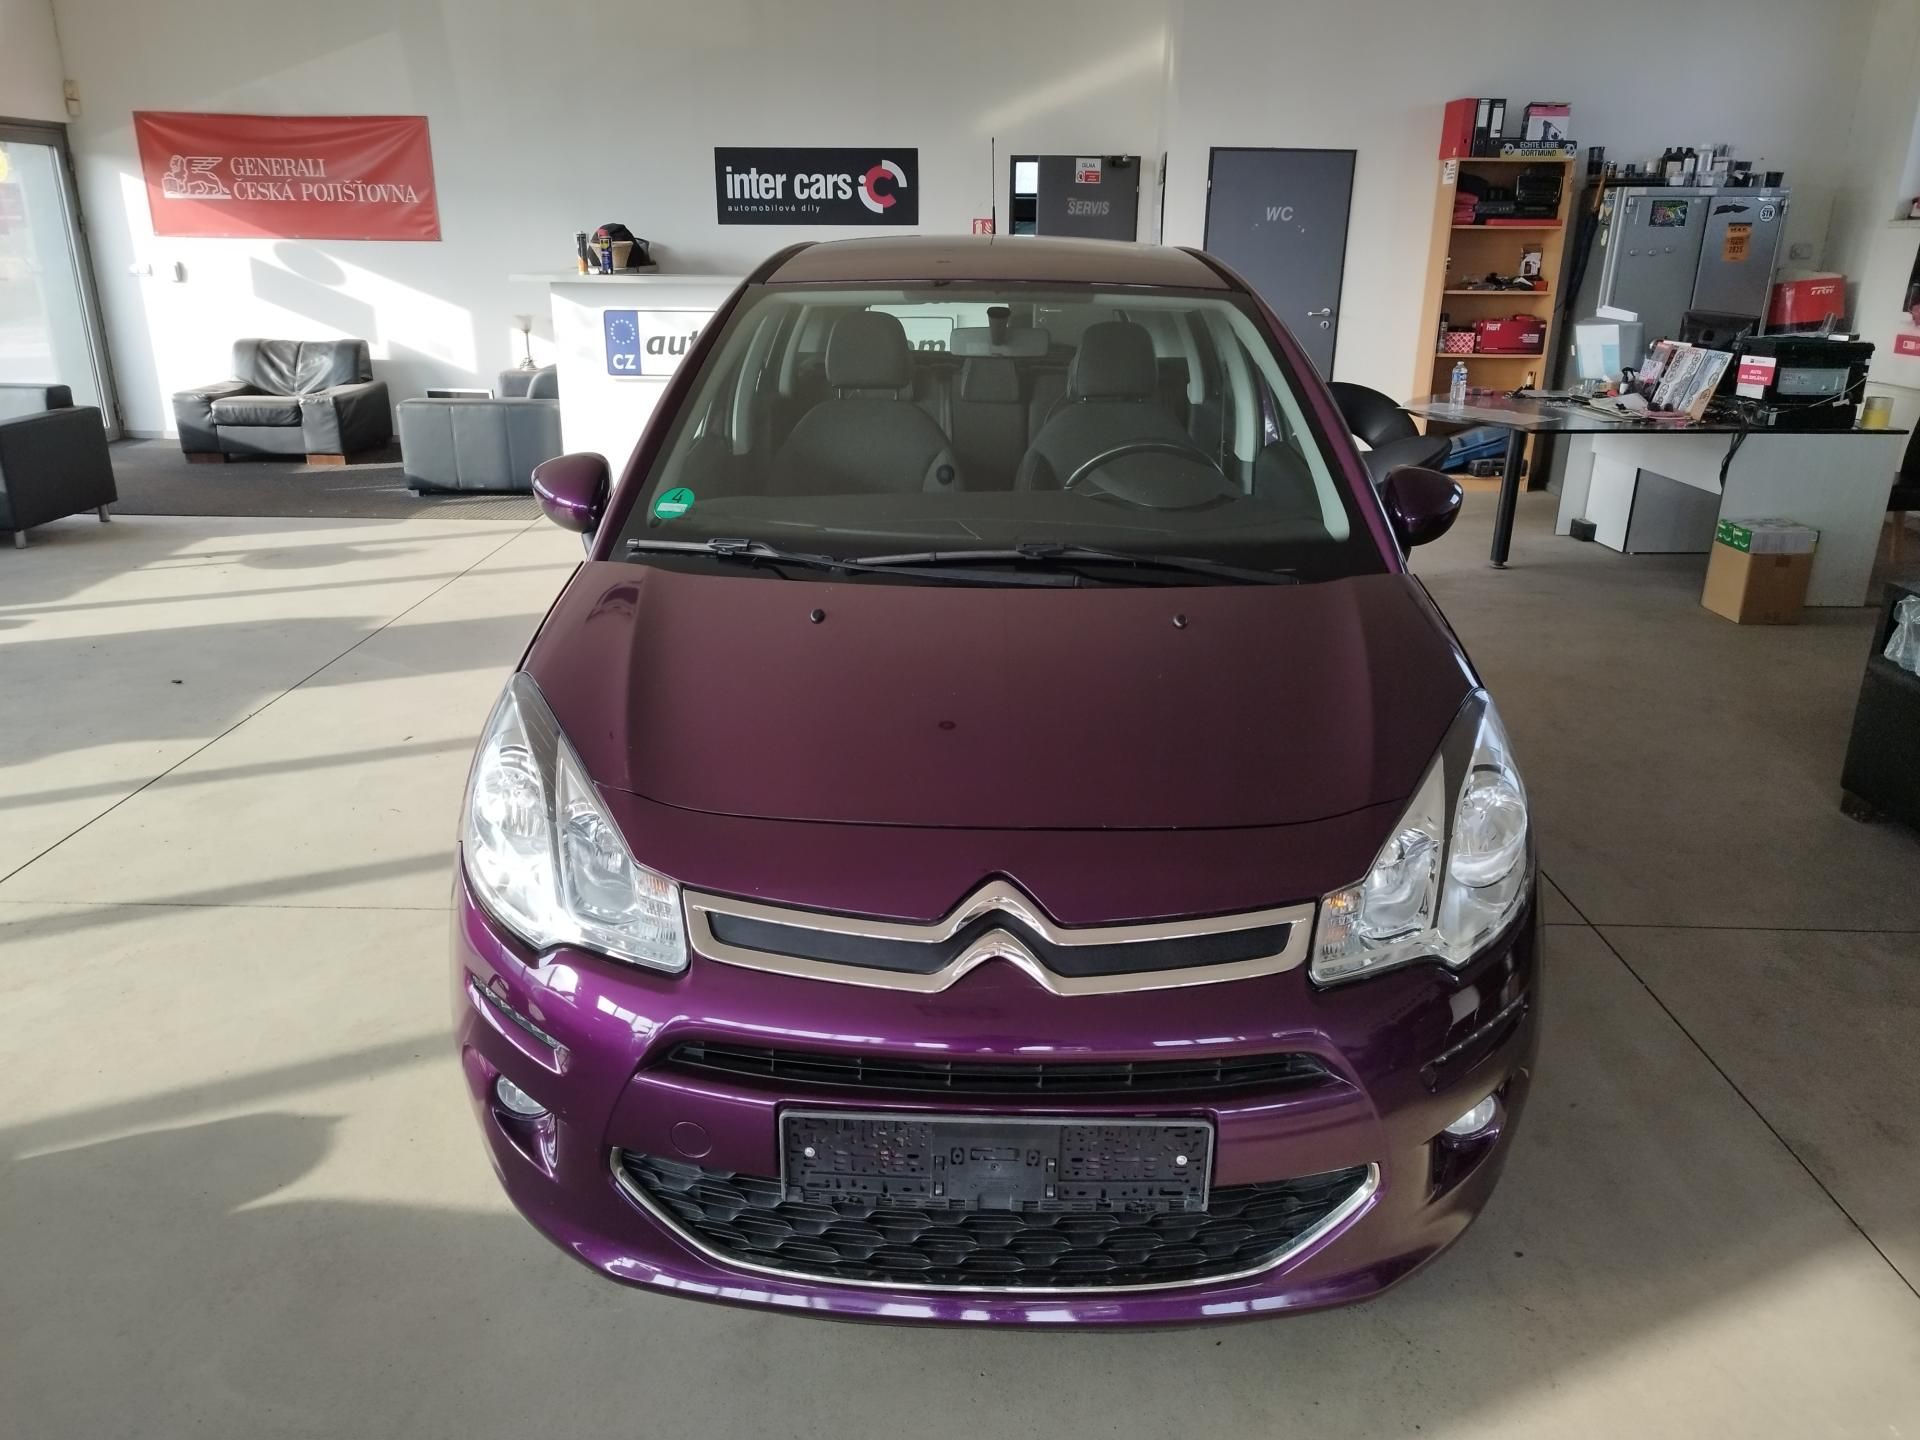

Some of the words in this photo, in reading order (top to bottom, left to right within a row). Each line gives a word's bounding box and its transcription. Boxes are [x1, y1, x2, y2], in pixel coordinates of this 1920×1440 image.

[230, 157, 327, 177] GENERALI
[233, 178, 297, 201] ČESKÁ
[301, 180, 420, 203] POJIŠŤOVNA
[726, 166, 787, 200] inter
[794, 173, 852, 200] cars
[727, 204, 796, 212] automobilové
[1066, 200, 1111, 216] SERVIS
[1266, 206, 1294, 222] WC
[612, 353, 637, 370] CZ
[672, 488, 685, 504] 4
